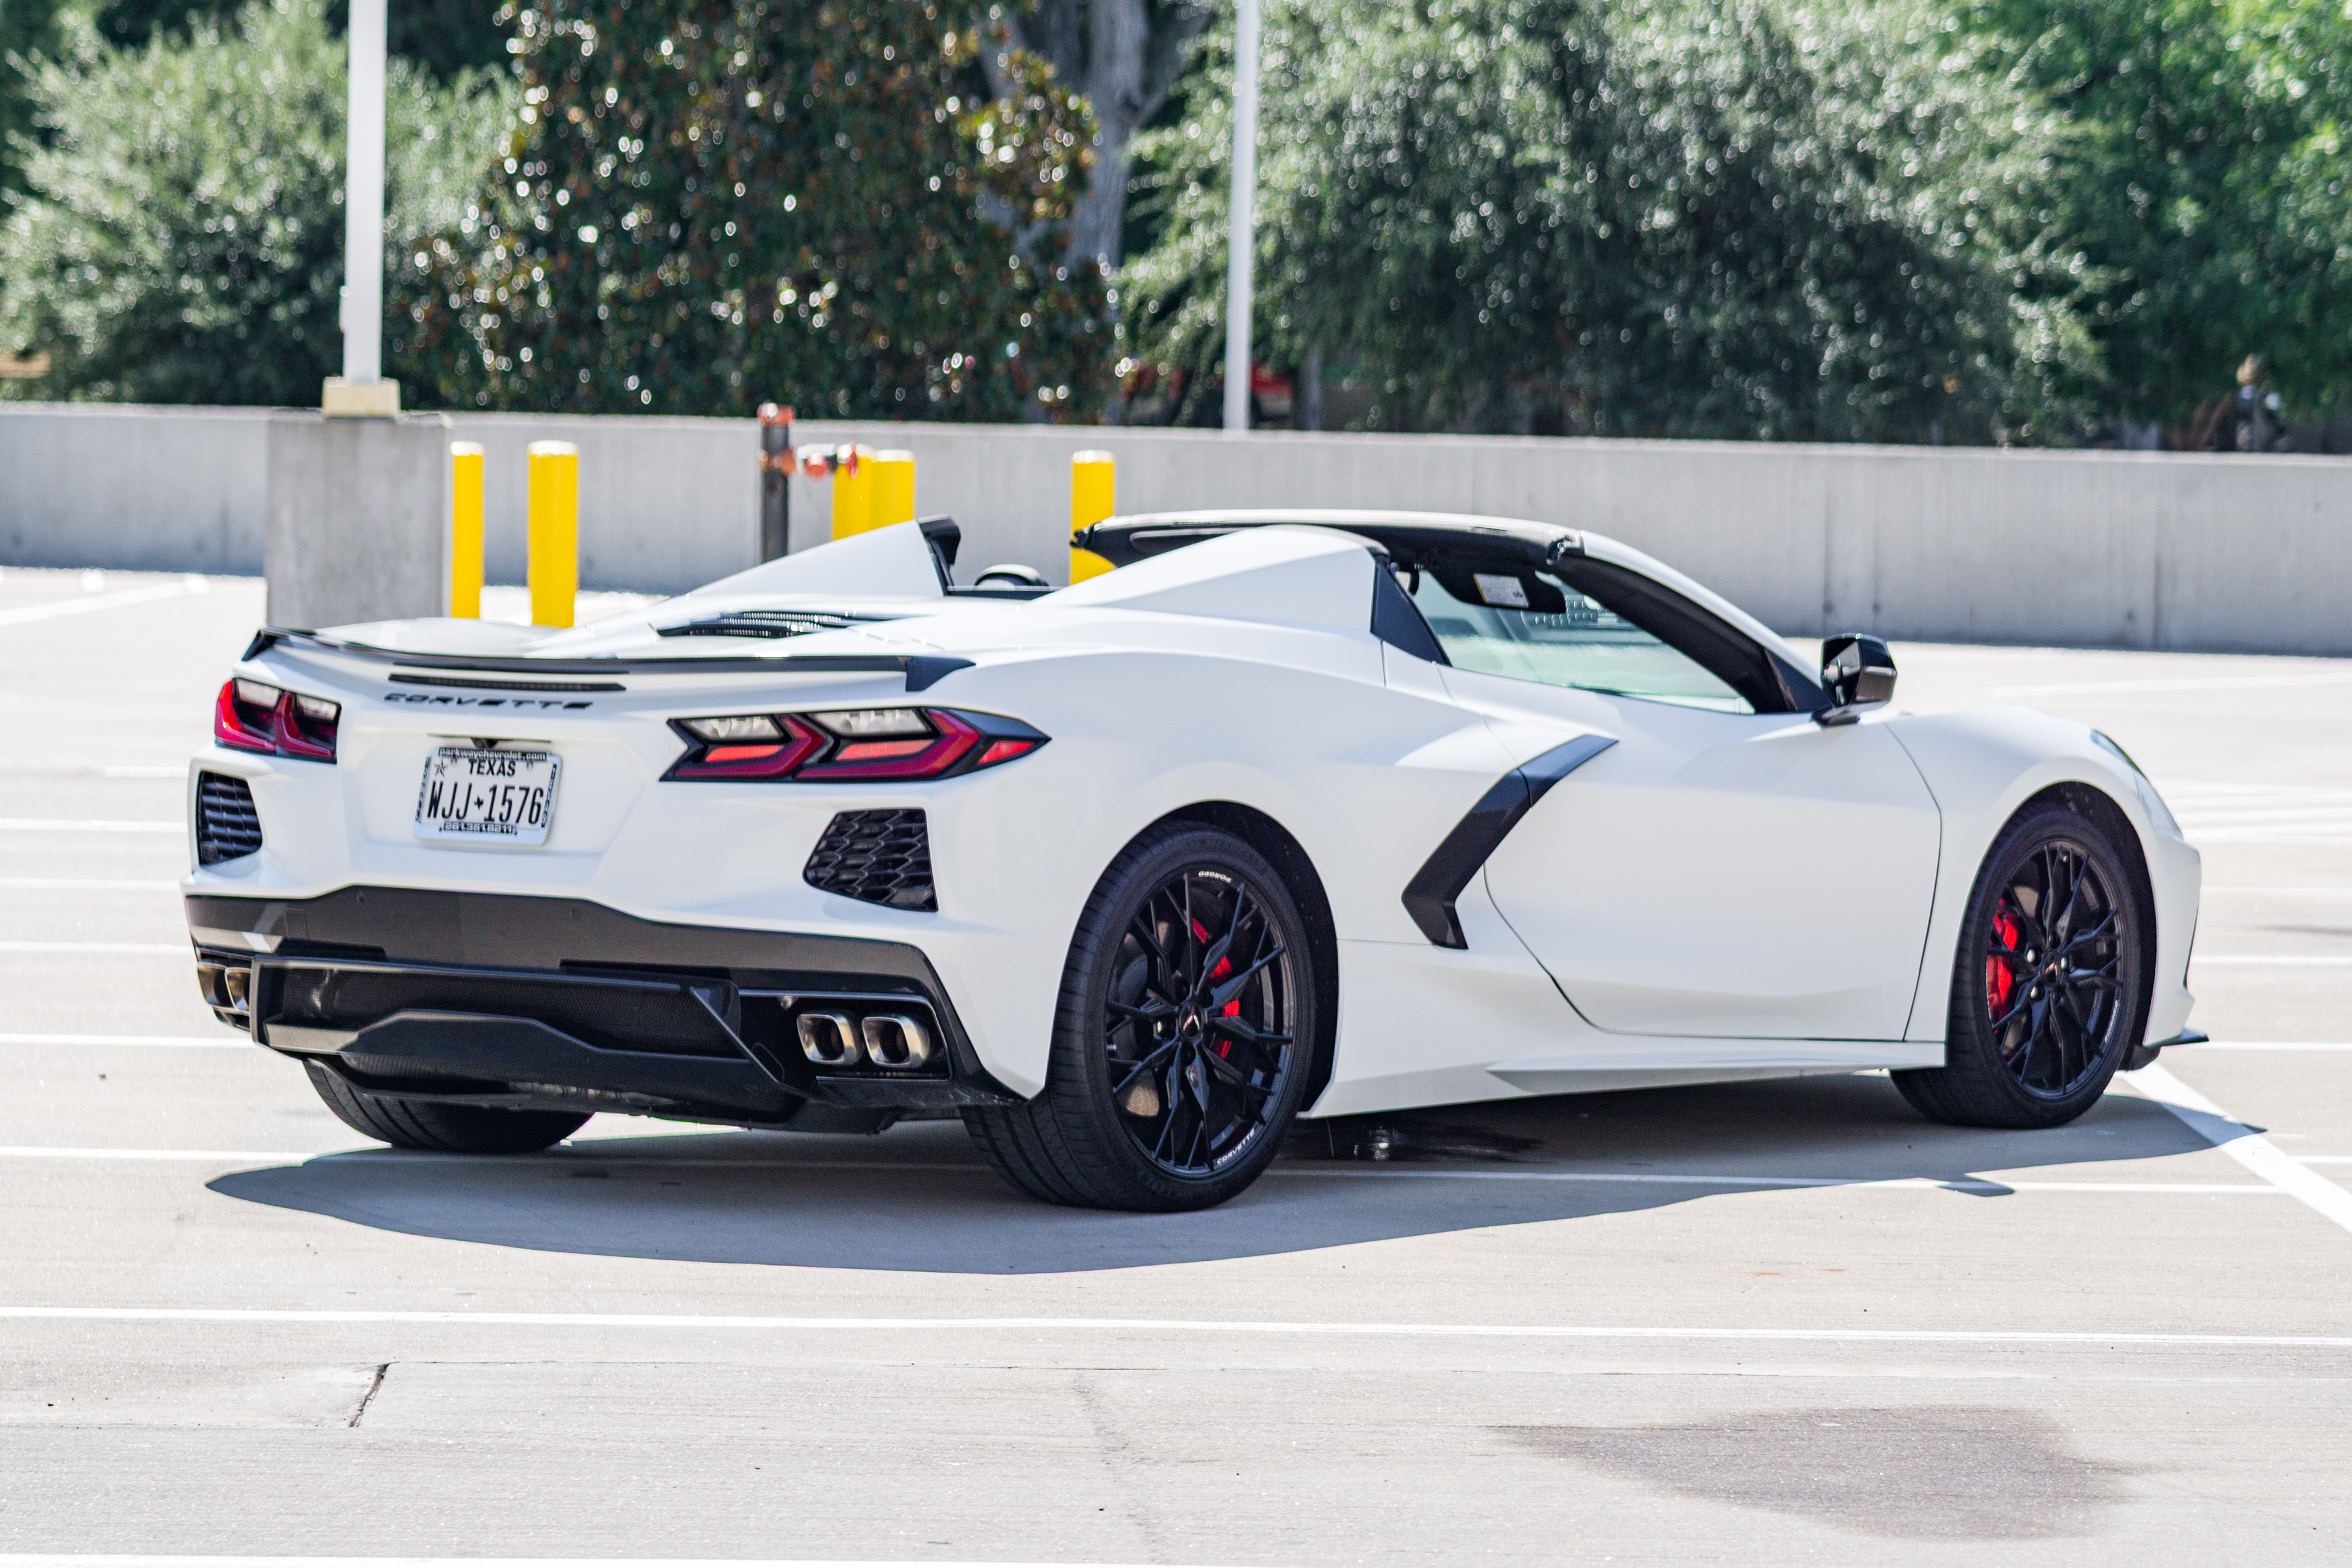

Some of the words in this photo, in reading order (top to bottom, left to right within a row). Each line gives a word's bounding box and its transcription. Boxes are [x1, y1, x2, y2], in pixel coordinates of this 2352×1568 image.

[384, 693, 593, 710] CORVETTE
[440, 747, 546, 761] parkwaychevrolet.com
[468, 759, 516, 777] TEXAS
[427, 781, 472, 819] WJJ
[483, 783, 544, 825] 1576
[1198, 870, 1232, 883] FORGED
[1217, 1128, 1255, 1165] CORVETTE
